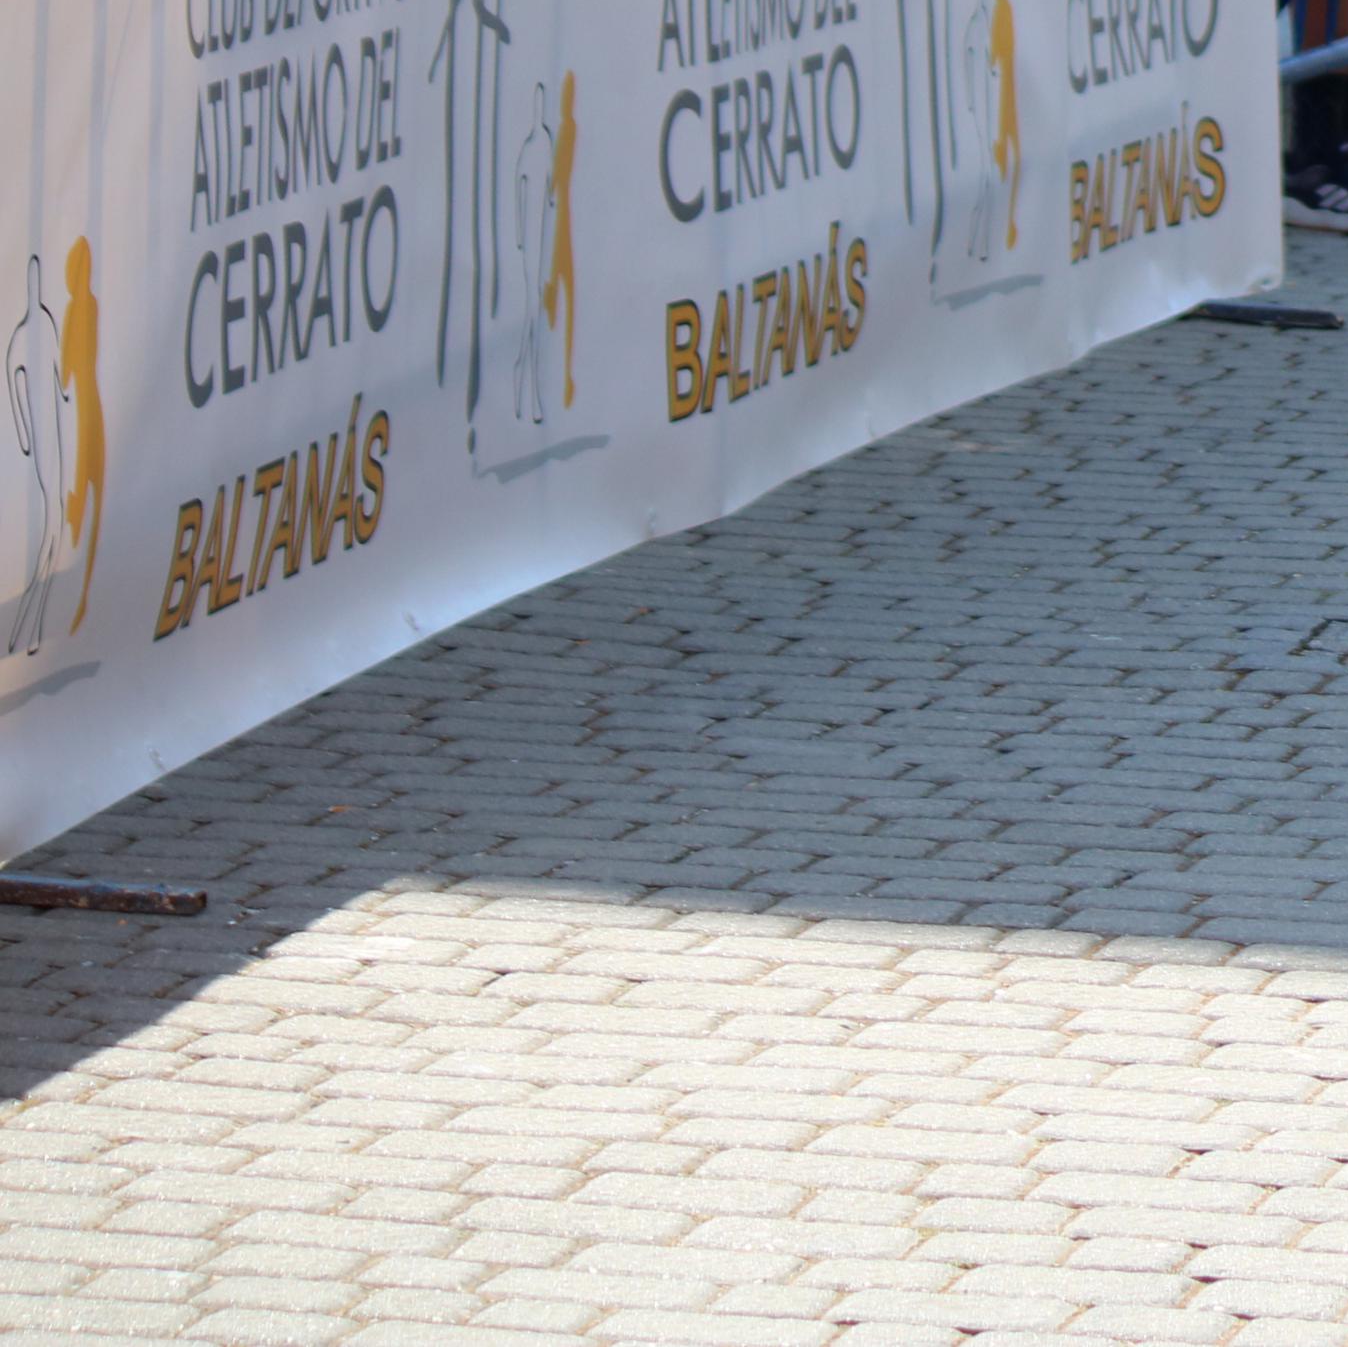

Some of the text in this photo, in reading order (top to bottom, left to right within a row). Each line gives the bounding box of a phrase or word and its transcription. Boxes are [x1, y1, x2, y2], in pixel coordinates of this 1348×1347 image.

[190, 26, 402, 233] ATLETISMO DEL
[659, 43, 861, 223] CERRATO
[1068, 100, 1226, 267] BALTANÁS
[185, 184, 399, 409] CERRATO
[665, 219, 868, 423] BALTANÁS
[153, 391, 390, 643] BALTANÁS
